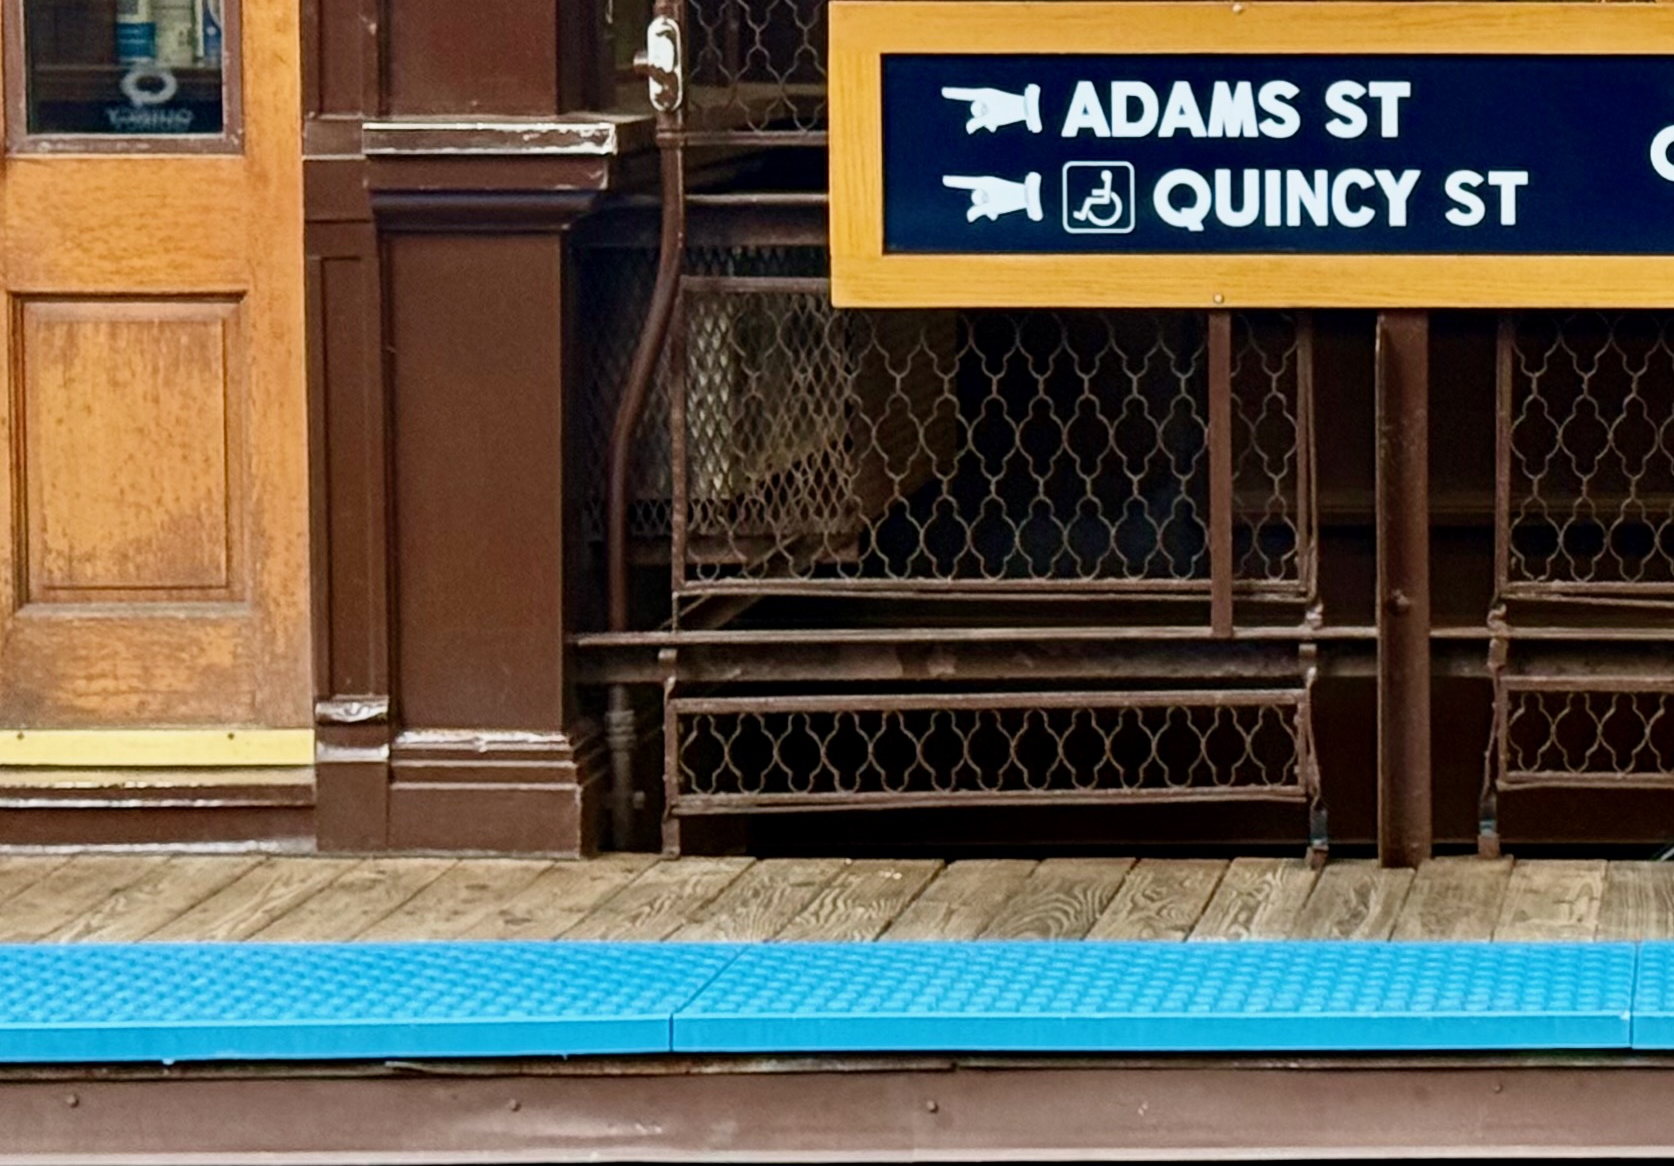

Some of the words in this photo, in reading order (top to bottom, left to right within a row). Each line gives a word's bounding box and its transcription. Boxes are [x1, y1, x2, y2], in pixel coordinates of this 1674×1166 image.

[1062, 80, 1301, 139] ADAMS
[1325, 80, 1411, 139] ST
[1153, 168, 1421, 232] QUINCY
[1444, 169, 1529, 227] ST
